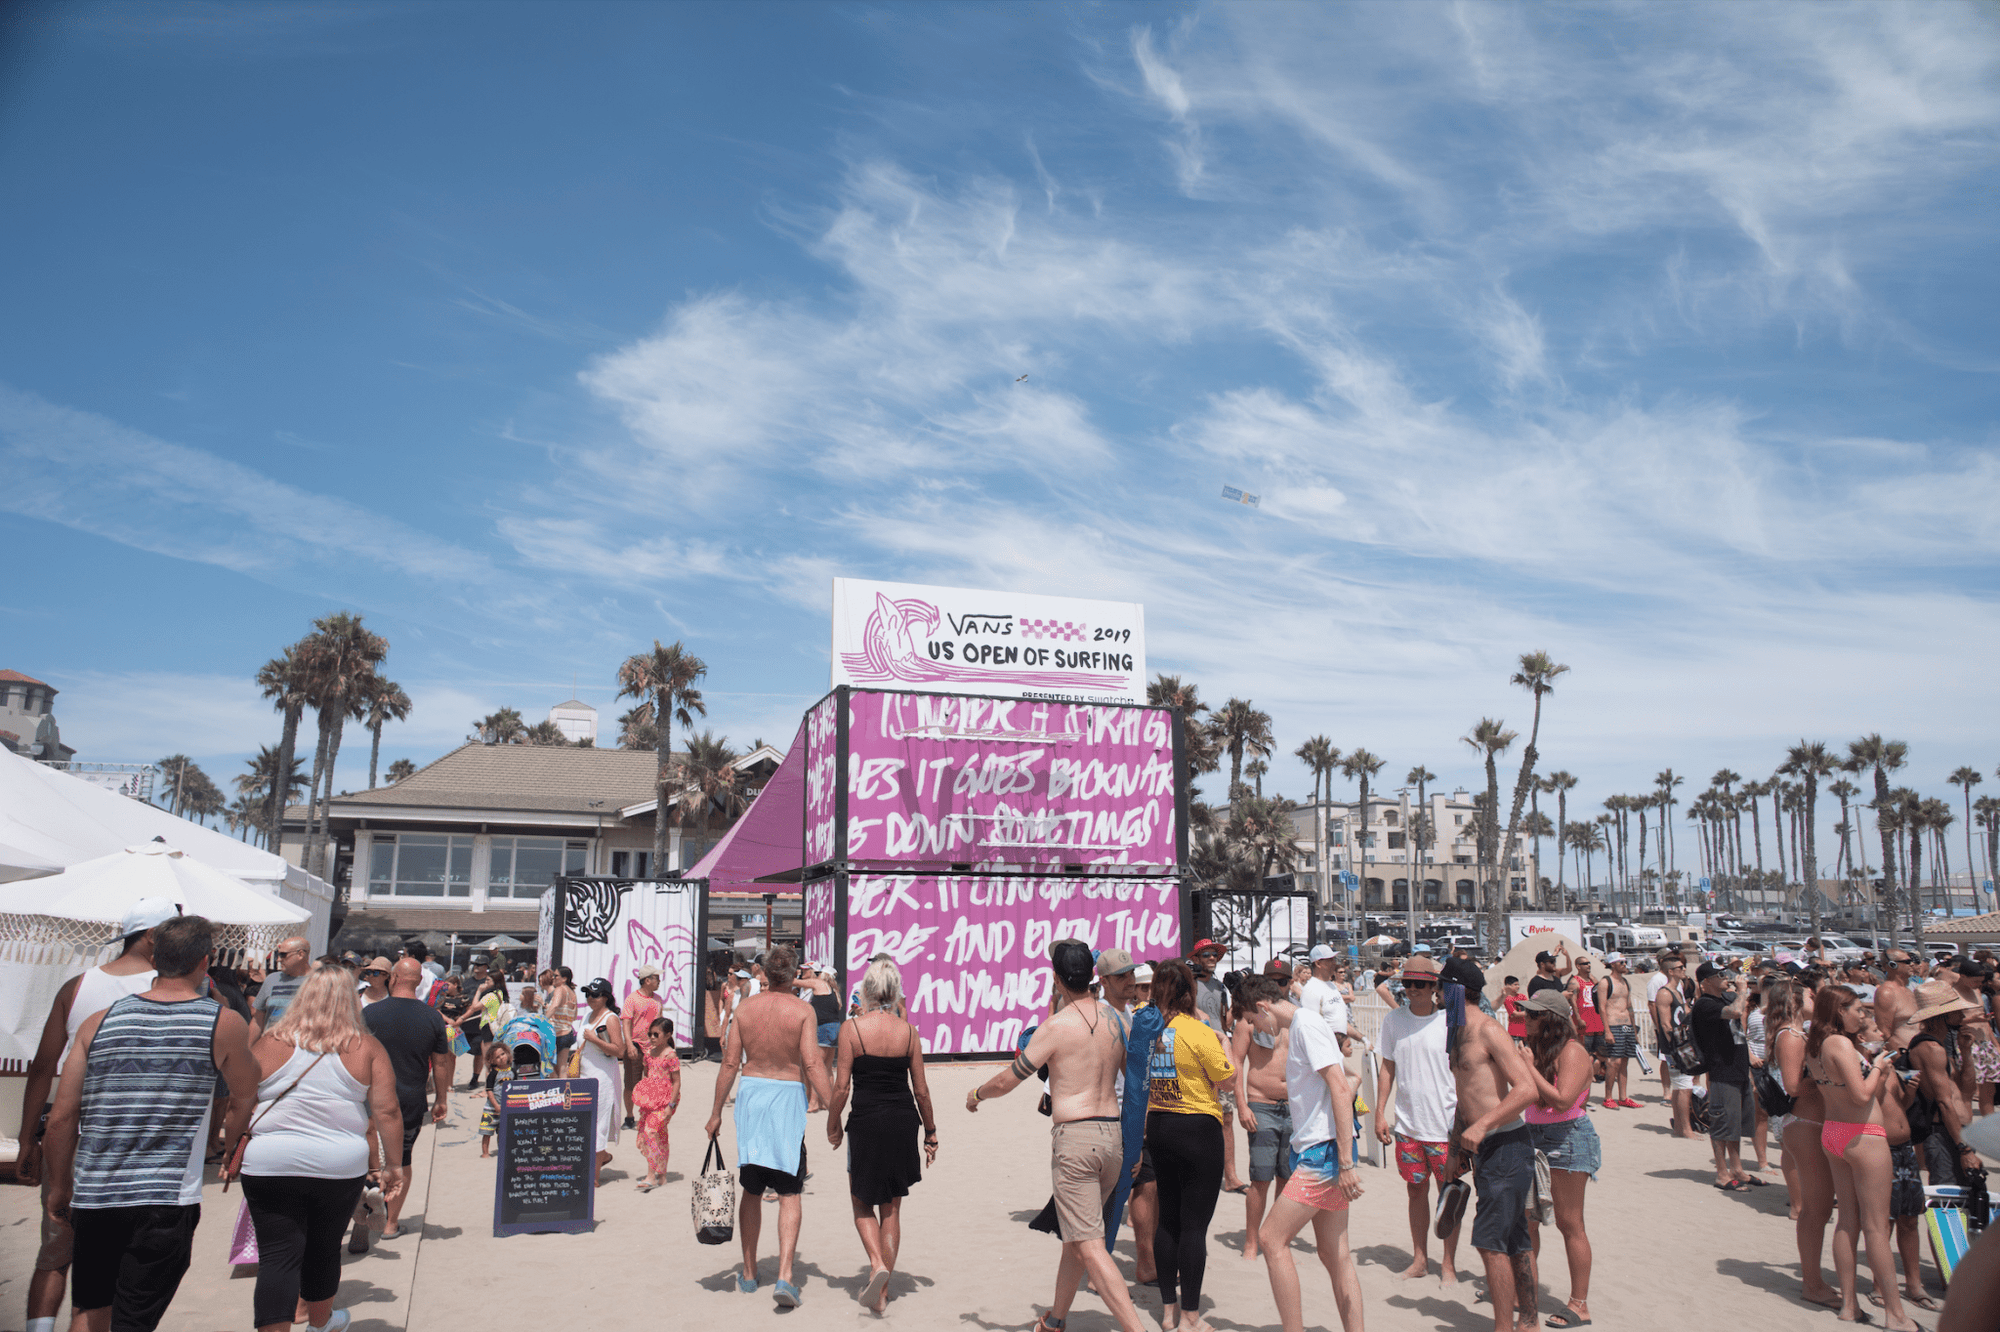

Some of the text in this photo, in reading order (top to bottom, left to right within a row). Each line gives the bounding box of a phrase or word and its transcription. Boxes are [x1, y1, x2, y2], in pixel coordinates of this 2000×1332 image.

[947, 612, 1130, 644] VANS 2019
[928, 641, 1132, 671] US OPEN OF SURFING
[1022, 692, 1072, 701] PRESENTED
[916, 757, 954, 803] IT
[953, 748, 1044, 799] GOES
[885, 806, 974, 857] DOWN
[944, 916, 1015, 966] AND
[1528, 925, 1555, 934] Ryder
[527, 1087, 560, 1102] LET'S GET
